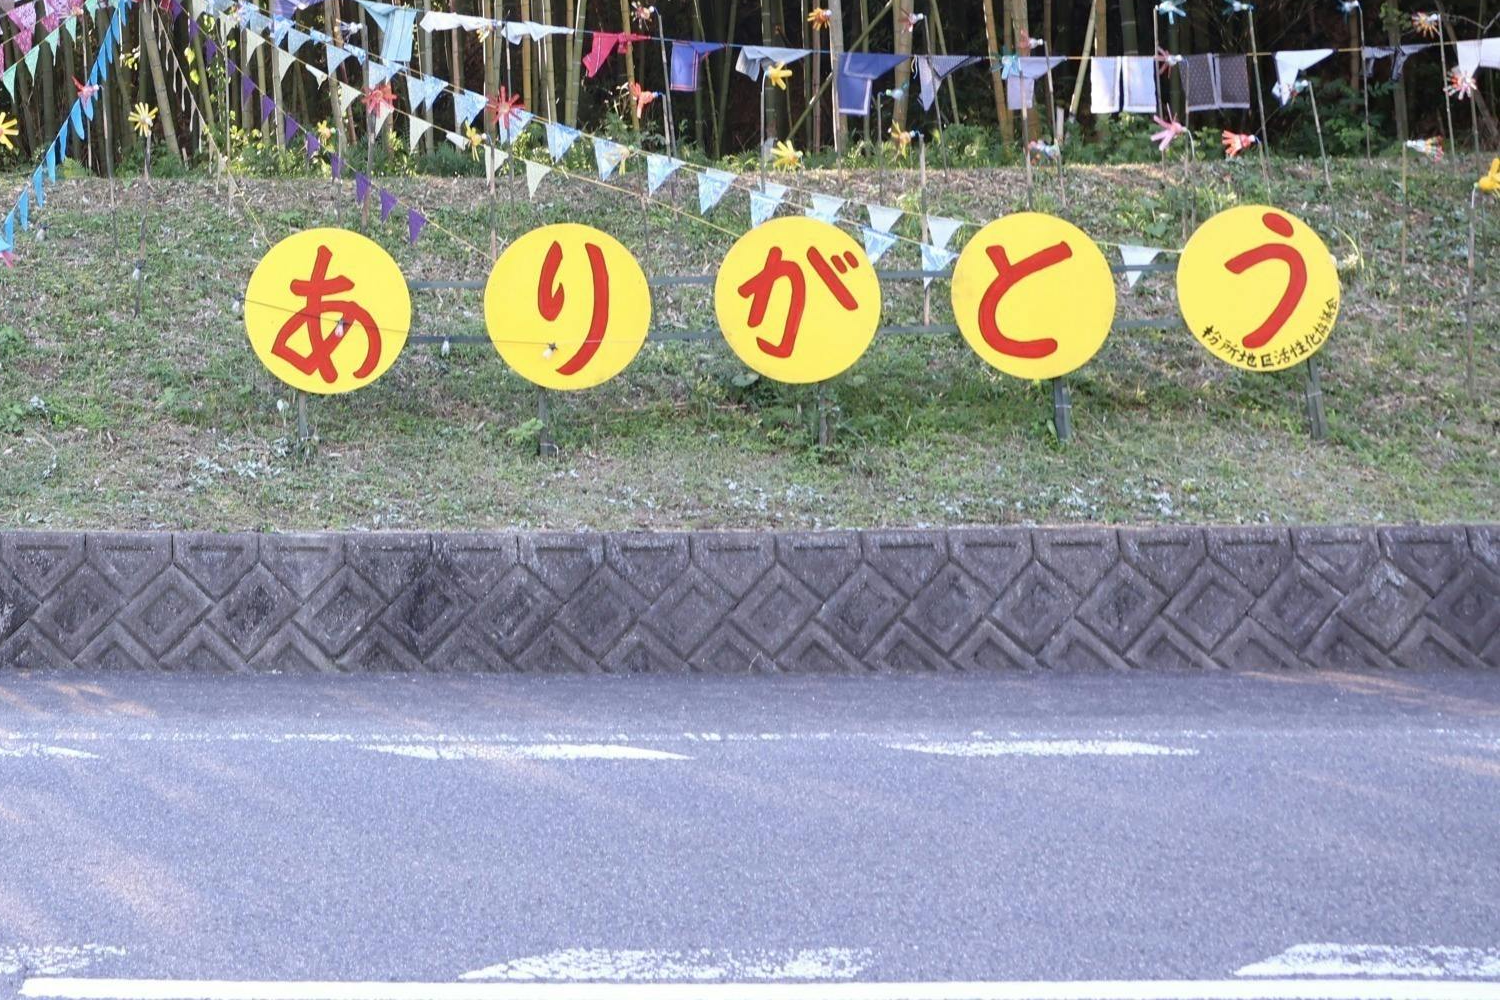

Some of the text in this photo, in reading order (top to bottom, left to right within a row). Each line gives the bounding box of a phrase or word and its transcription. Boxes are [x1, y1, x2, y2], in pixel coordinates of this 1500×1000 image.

[270, 211, 1308, 385] ありがとう
